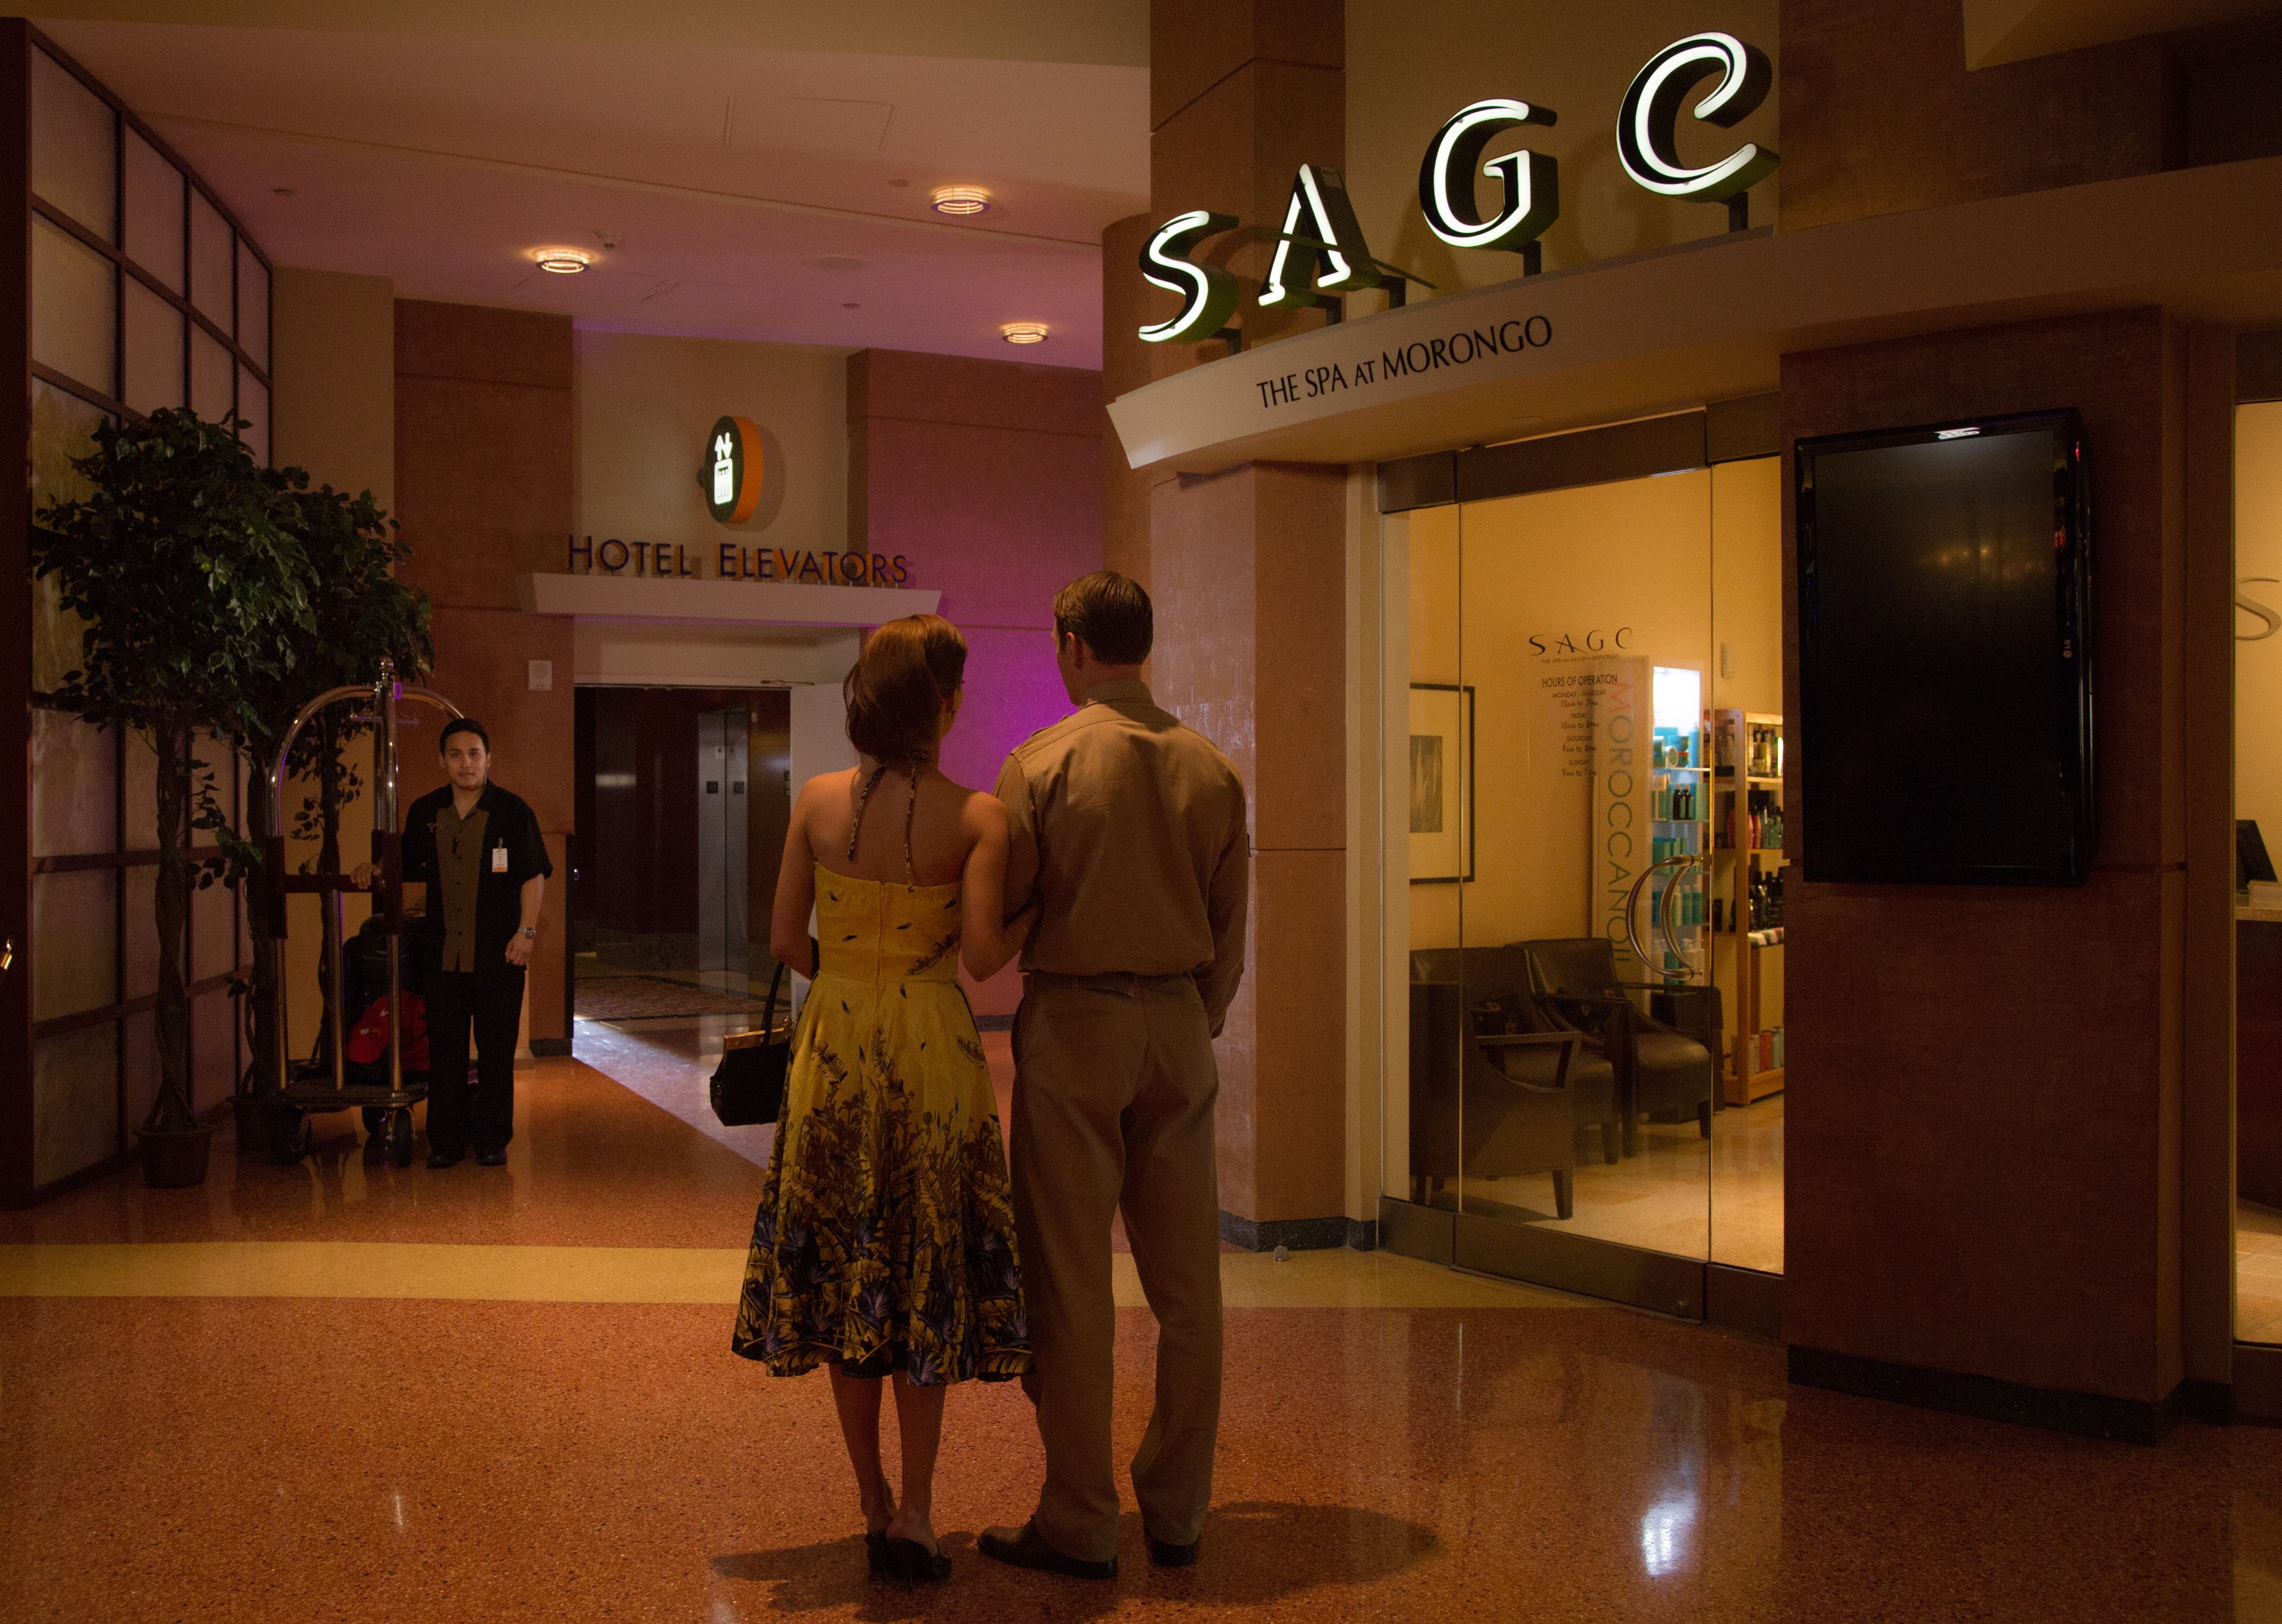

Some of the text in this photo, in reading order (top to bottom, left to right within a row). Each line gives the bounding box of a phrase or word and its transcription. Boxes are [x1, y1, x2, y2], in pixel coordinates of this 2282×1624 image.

[1256, 316, 1553, 409] THE SPA AT MORONGO
[568, 534, 908, 584] HOTEL ELEVATORS
[1542, 674, 1618, 688] HOURS OF OPERATION
